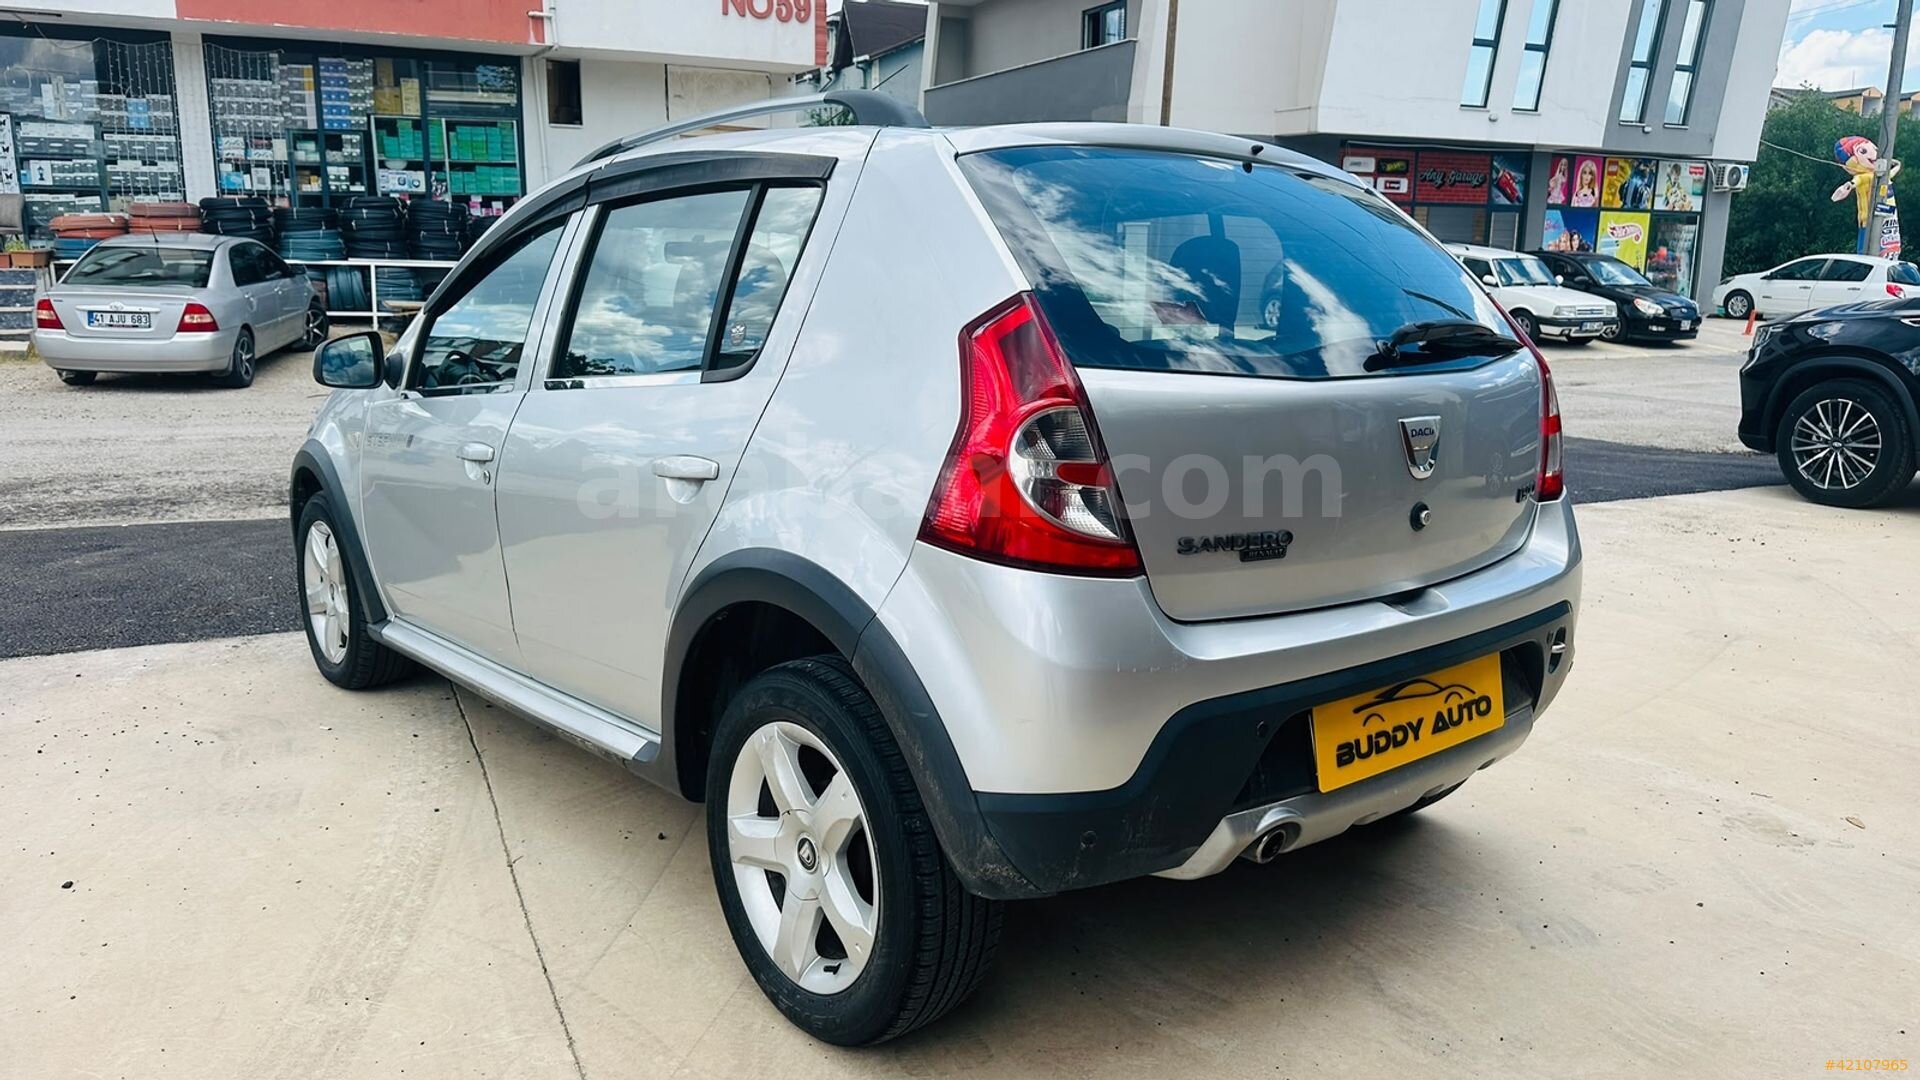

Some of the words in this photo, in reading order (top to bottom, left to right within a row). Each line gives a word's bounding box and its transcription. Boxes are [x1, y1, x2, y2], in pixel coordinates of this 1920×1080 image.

[1419, 167, 1446, 189] Any
[1447, 169, 1487, 188] Garage
[93, 313, 104, 323] 41
[109, 313, 127, 324] AJU
[130, 314, 149, 325] 683
[1177, 529, 1294, 555] SANDERO
[1336, 717, 1425, 769] BUDDY
[1431, 694, 1493, 735] AUTO
